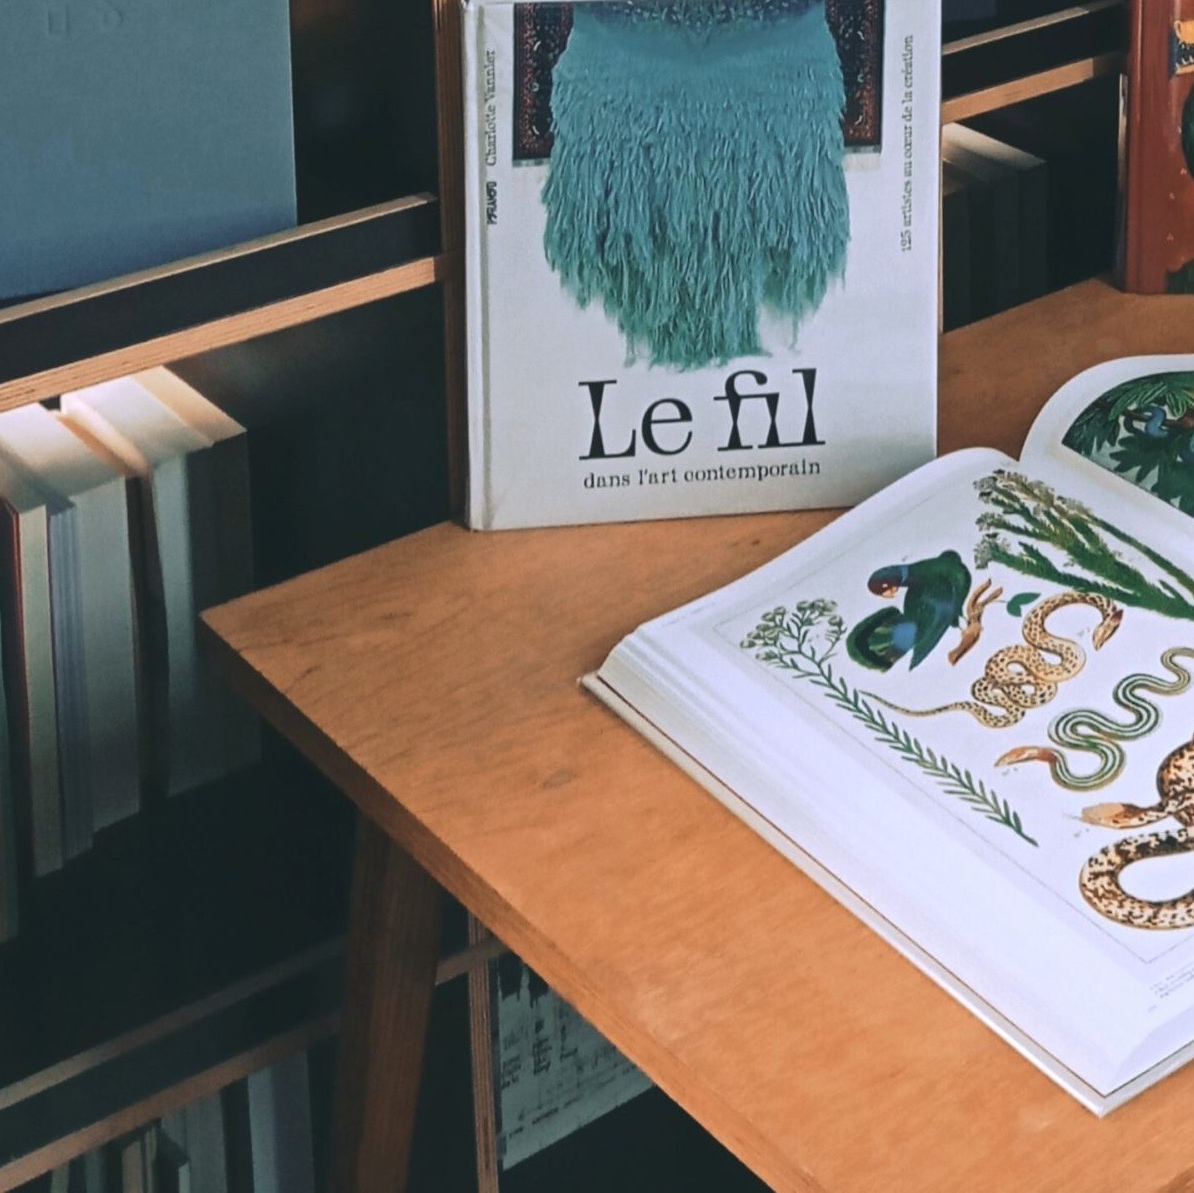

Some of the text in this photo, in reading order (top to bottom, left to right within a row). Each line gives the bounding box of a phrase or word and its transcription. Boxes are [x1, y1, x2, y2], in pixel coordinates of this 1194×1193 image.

[901, 35, 914, 88] création
[484, 50, 497, 167] Charlotte Vannier
[902, 91, 913, 104] la
[902, 108, 913, 122] de
[904, 161, 913, 178] au
[901, 180, 912, 227] artistes
[901, 230, 912, 252] 125
[578, 368, 826, 461] Le fil
[583, 459, 821, 489] dans l'art contemporain
